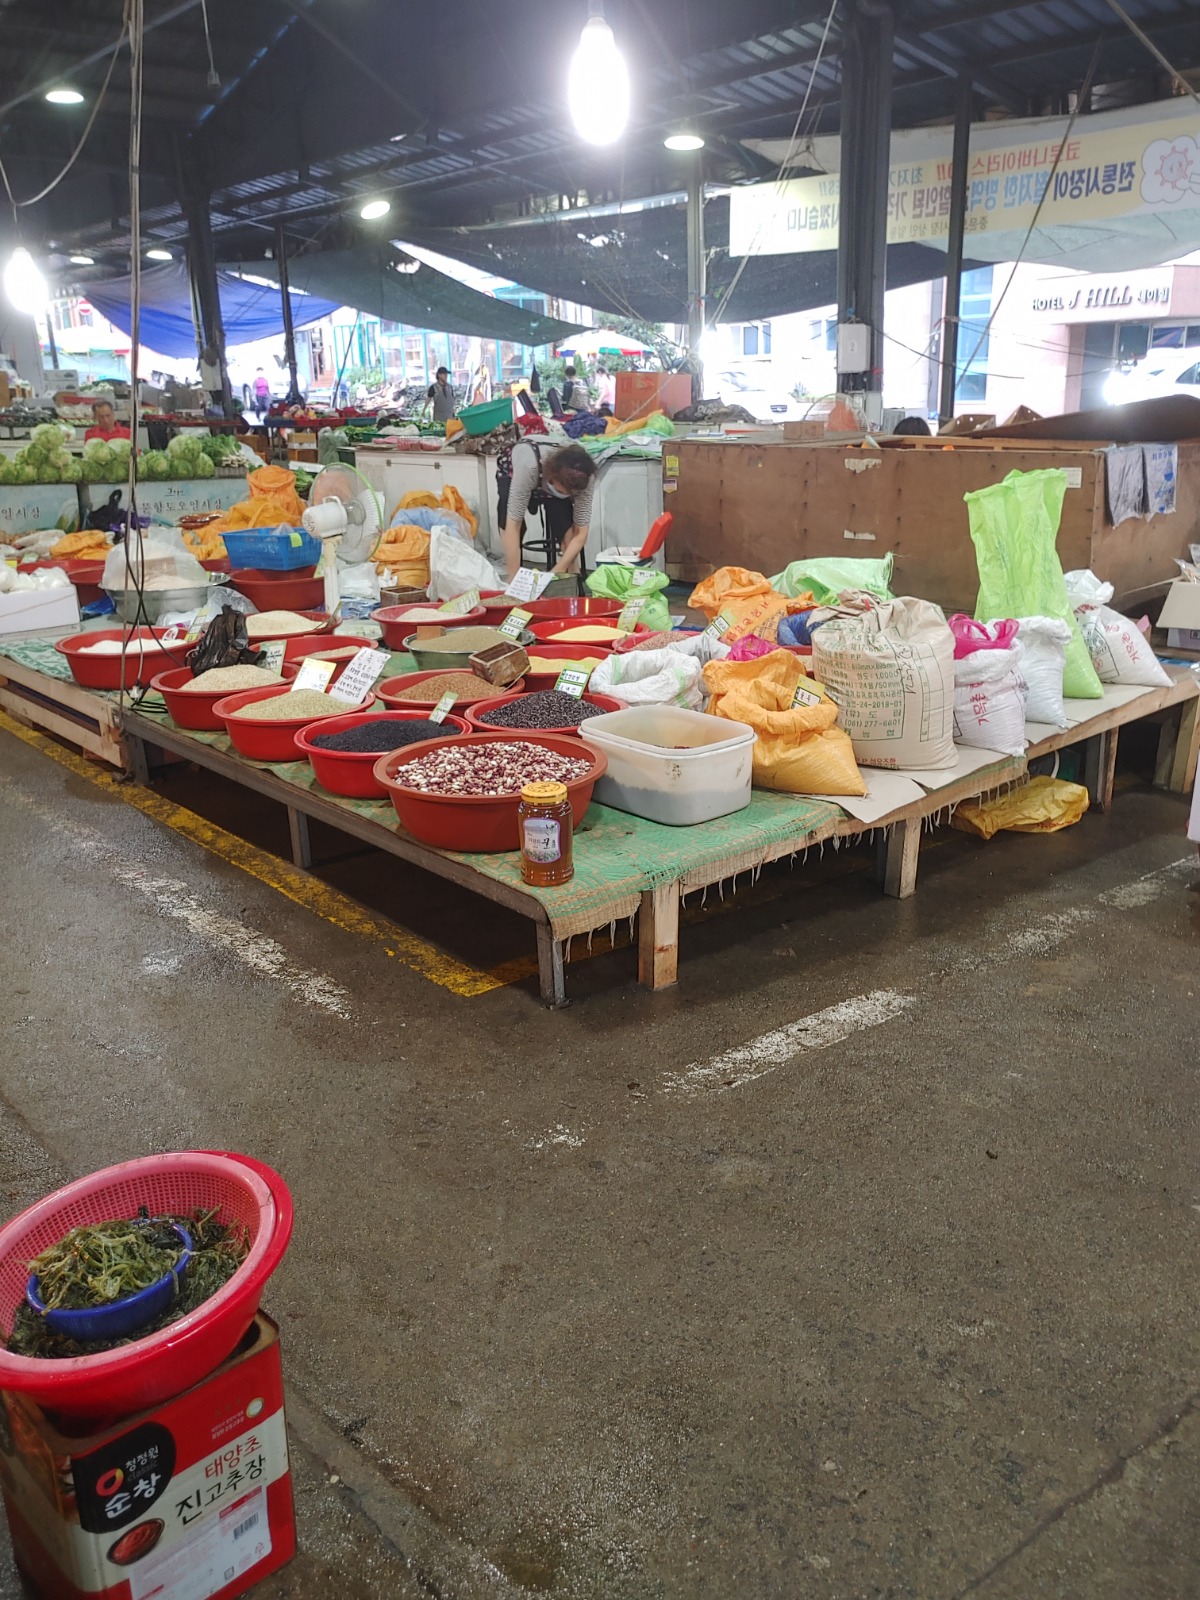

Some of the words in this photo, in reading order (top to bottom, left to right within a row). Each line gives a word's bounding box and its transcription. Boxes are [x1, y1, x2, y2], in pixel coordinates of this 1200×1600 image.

[1033, 297, 1064, 311] HOTEL
[1069, 289, 1081, 309] J
[1085, 286, 1132, 308] HILL
[844, 719, 862, 728] (061)
[124, 1445, 159, 1472] 청정원
[204, 1435, 263, 1479] 태양초
[104, 1472, 162, 1520] 순창
[175, 1453, 267, 1526] 진고추장
